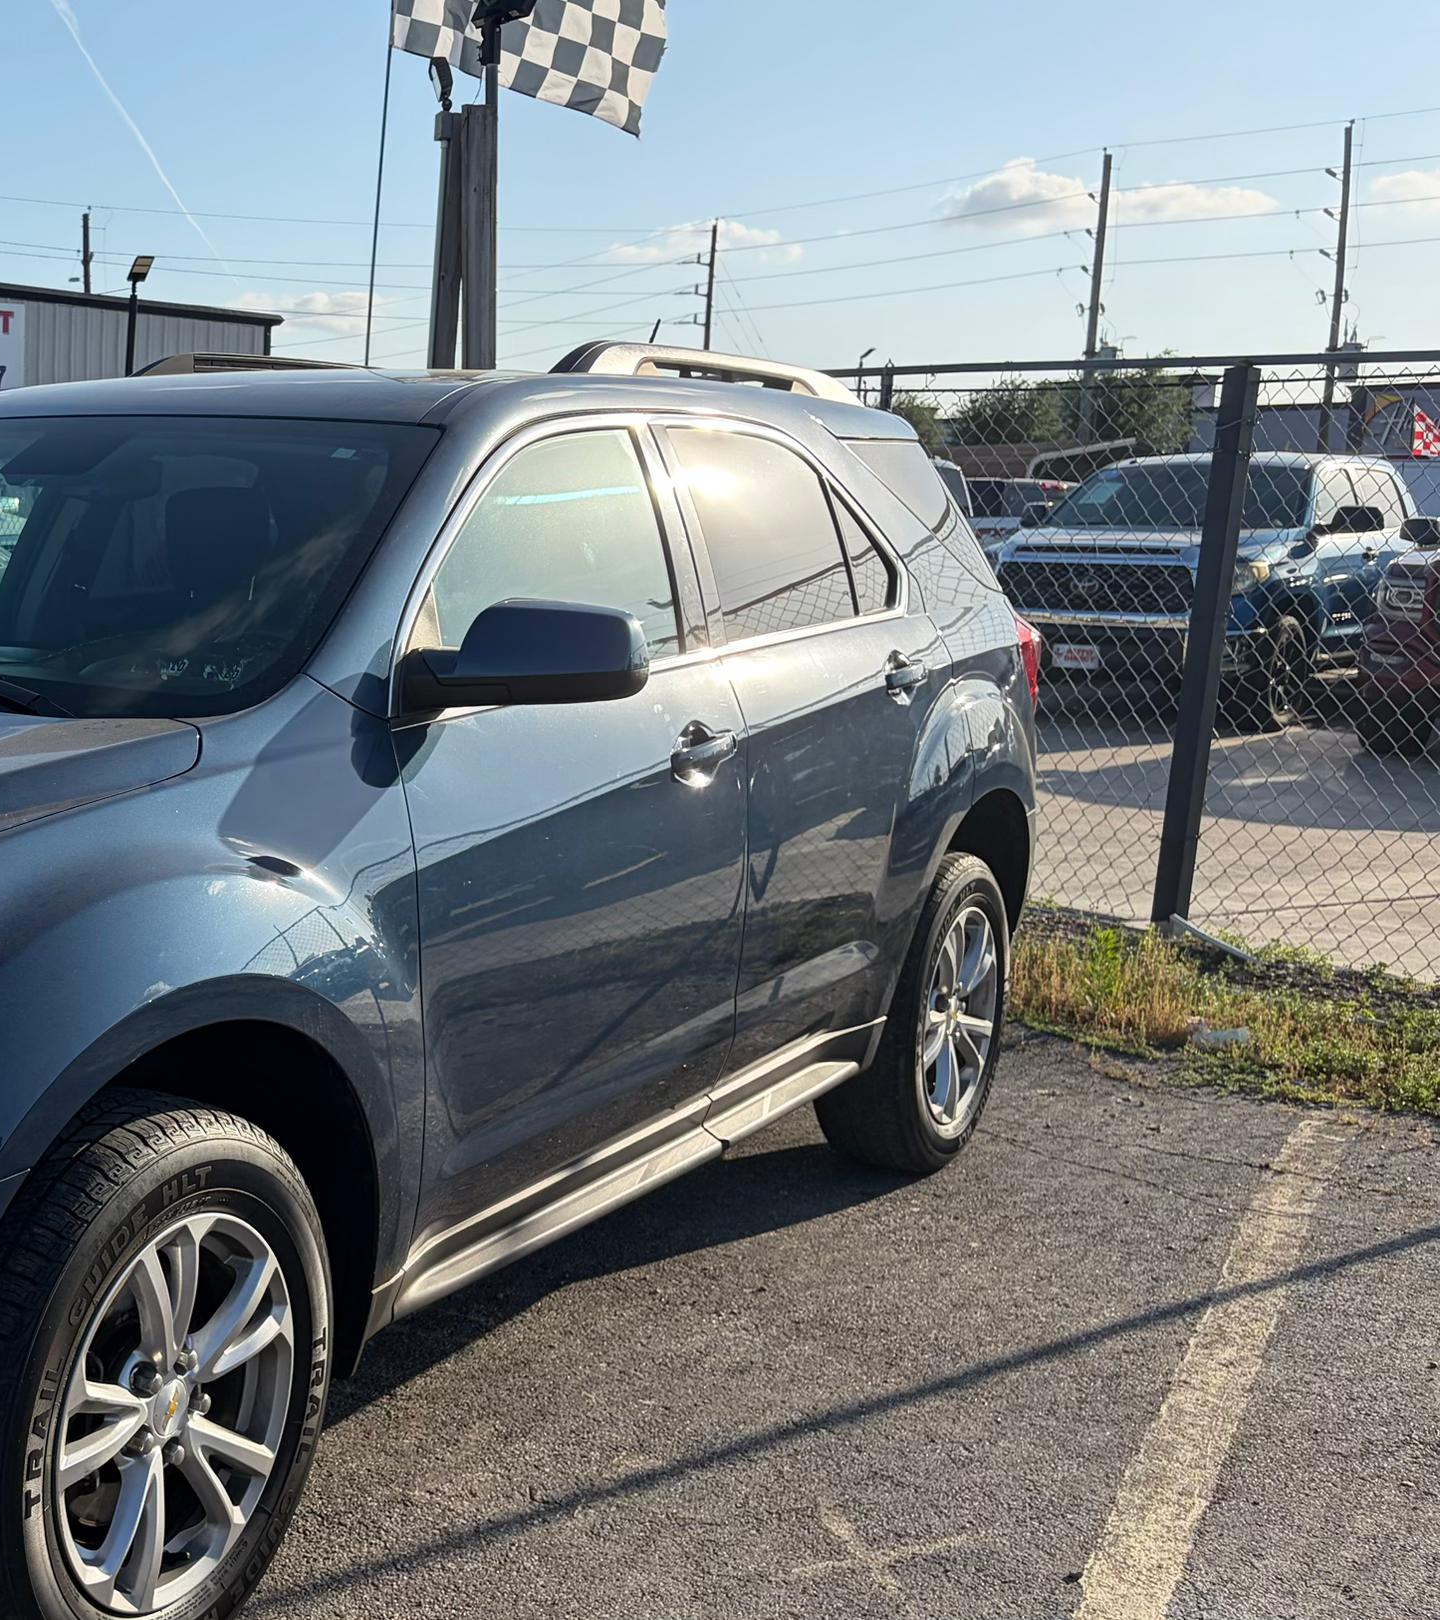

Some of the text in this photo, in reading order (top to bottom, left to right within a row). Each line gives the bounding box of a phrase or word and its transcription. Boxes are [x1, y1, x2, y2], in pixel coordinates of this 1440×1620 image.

[23, 1357, 64, 1520] TRAIL
[68, 1203, 151, 1328] GUIDE
[161, 1165, 213, 1205] HLT
[295, 1326, 327, 1465] TRAIL
